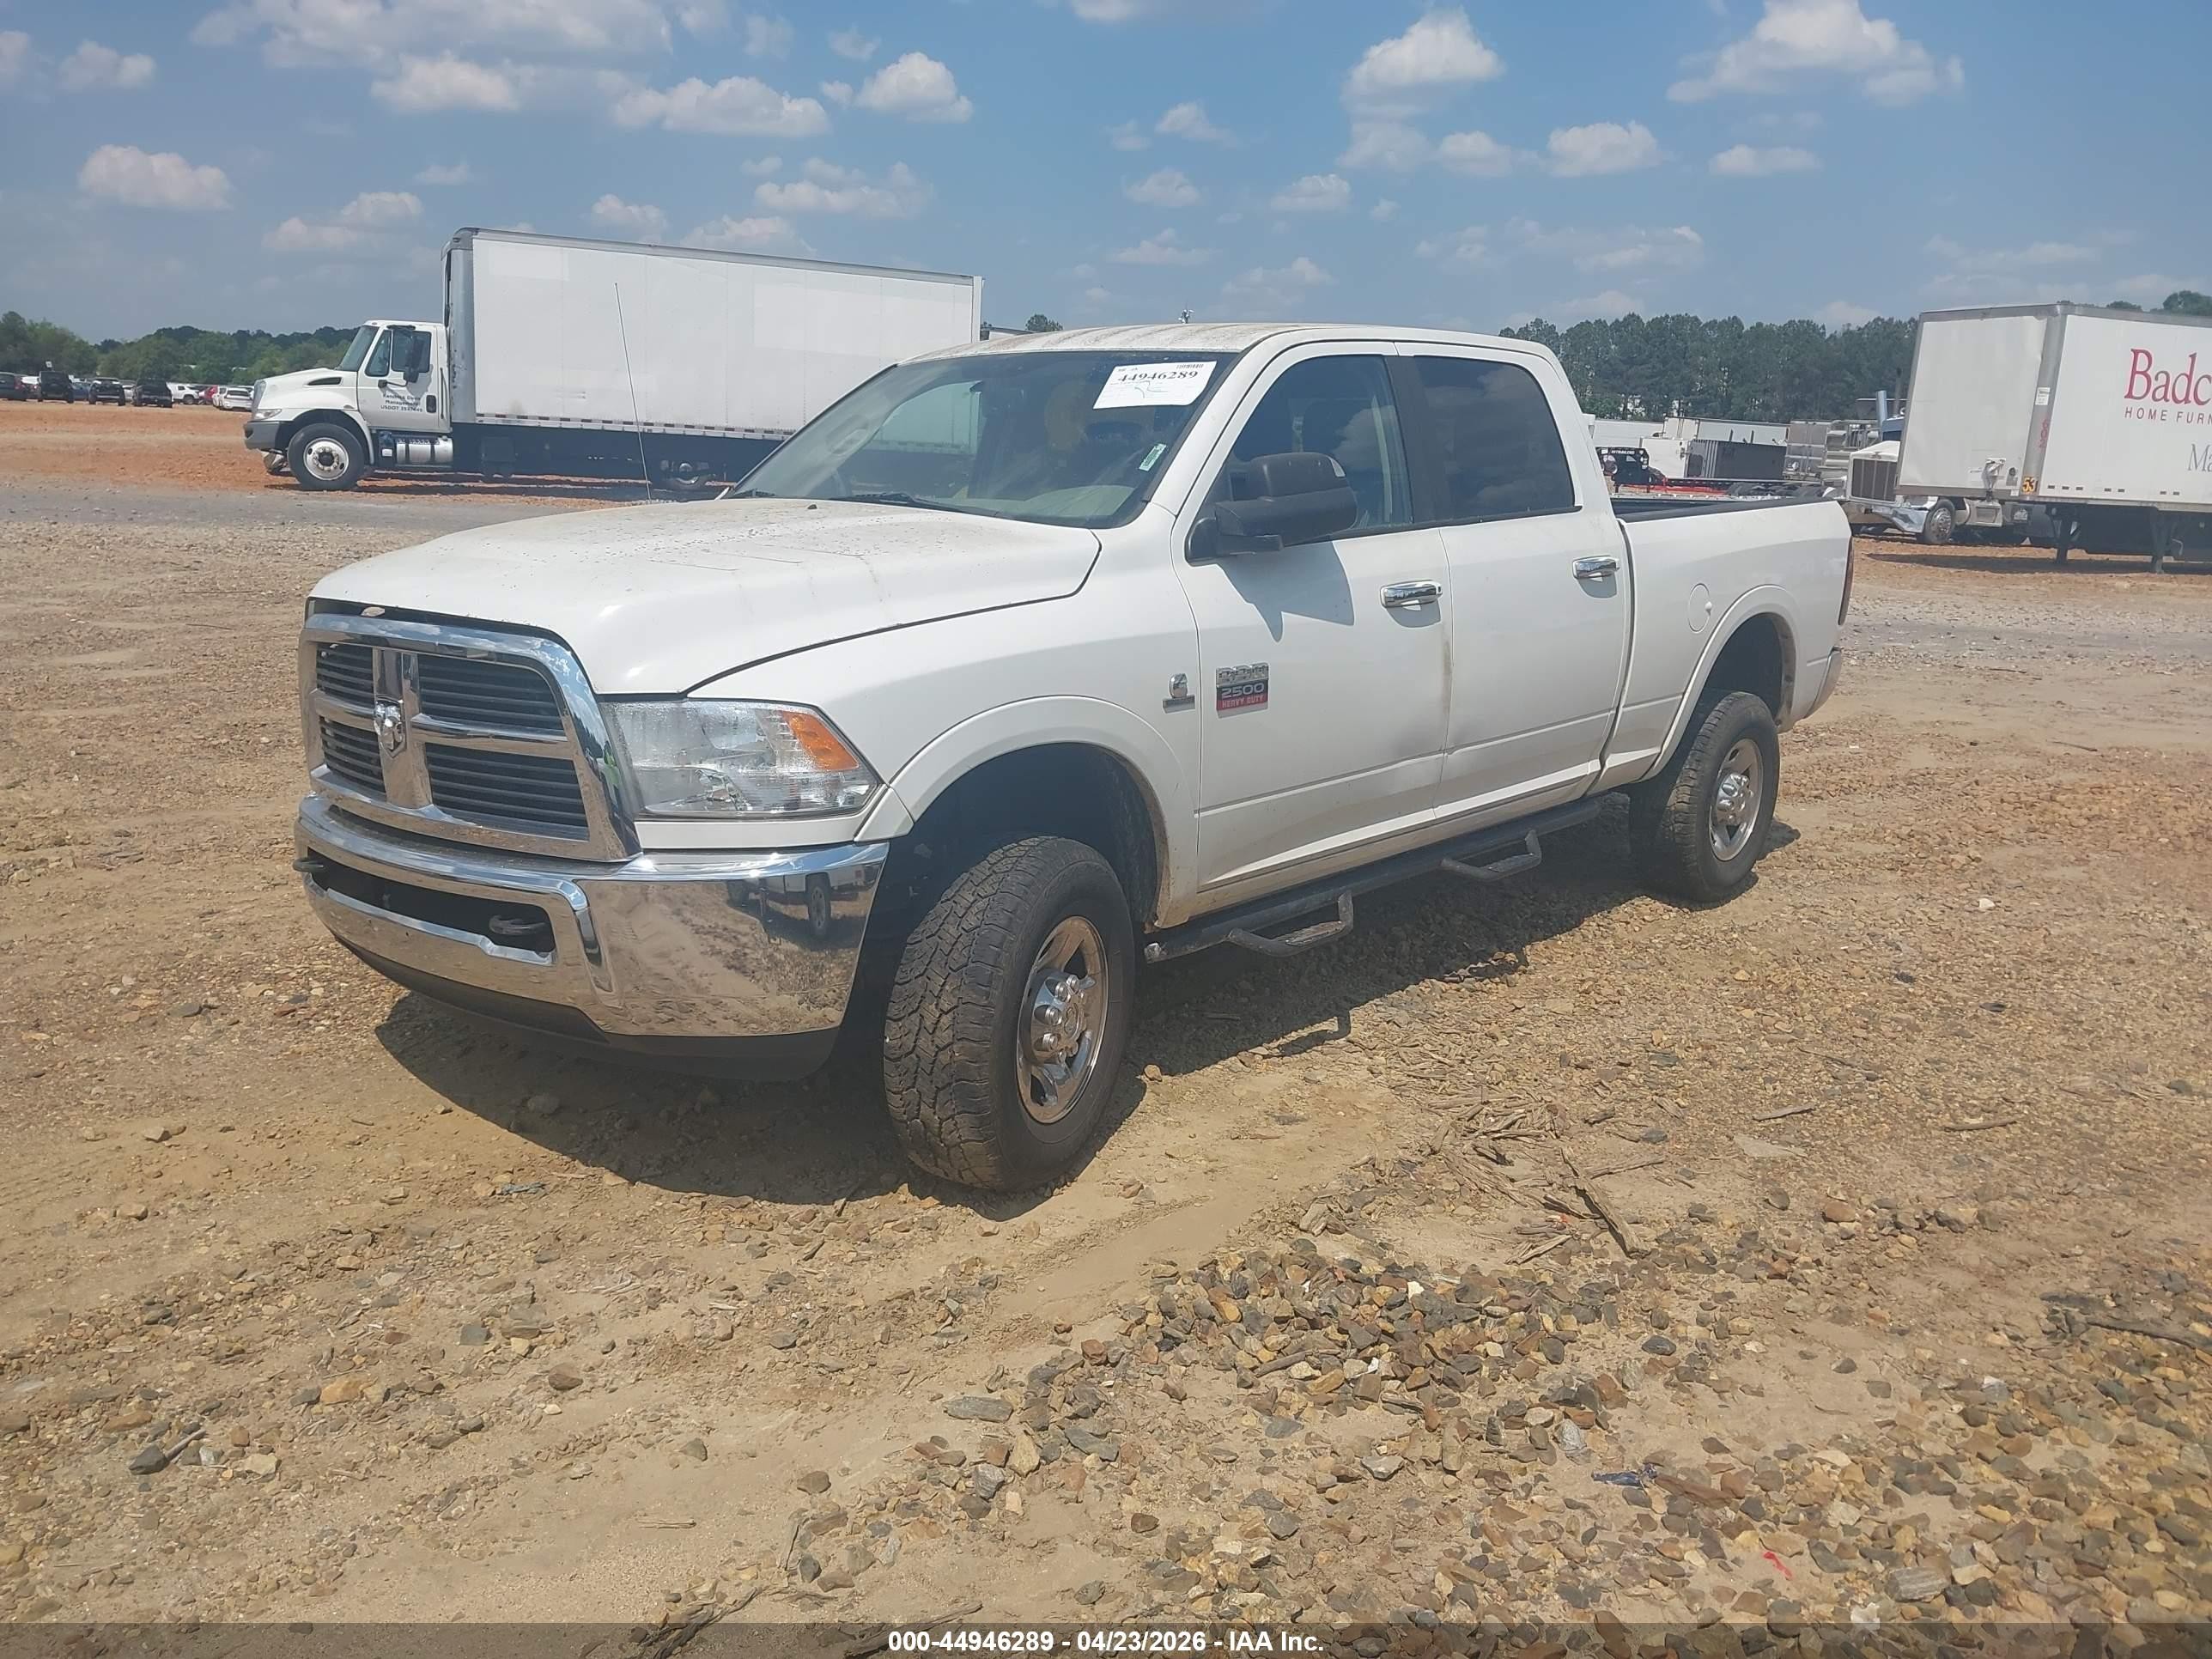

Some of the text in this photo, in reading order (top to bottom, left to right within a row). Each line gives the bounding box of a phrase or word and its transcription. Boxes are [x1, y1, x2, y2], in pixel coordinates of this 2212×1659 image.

[1118, 370, 1199, 382] 44946289
[2124, 406, 2168, 422] HOME
[1222, 683, 1264, 699] 2500
[1222, 694, 1264, 708] HEAVY DUTY
